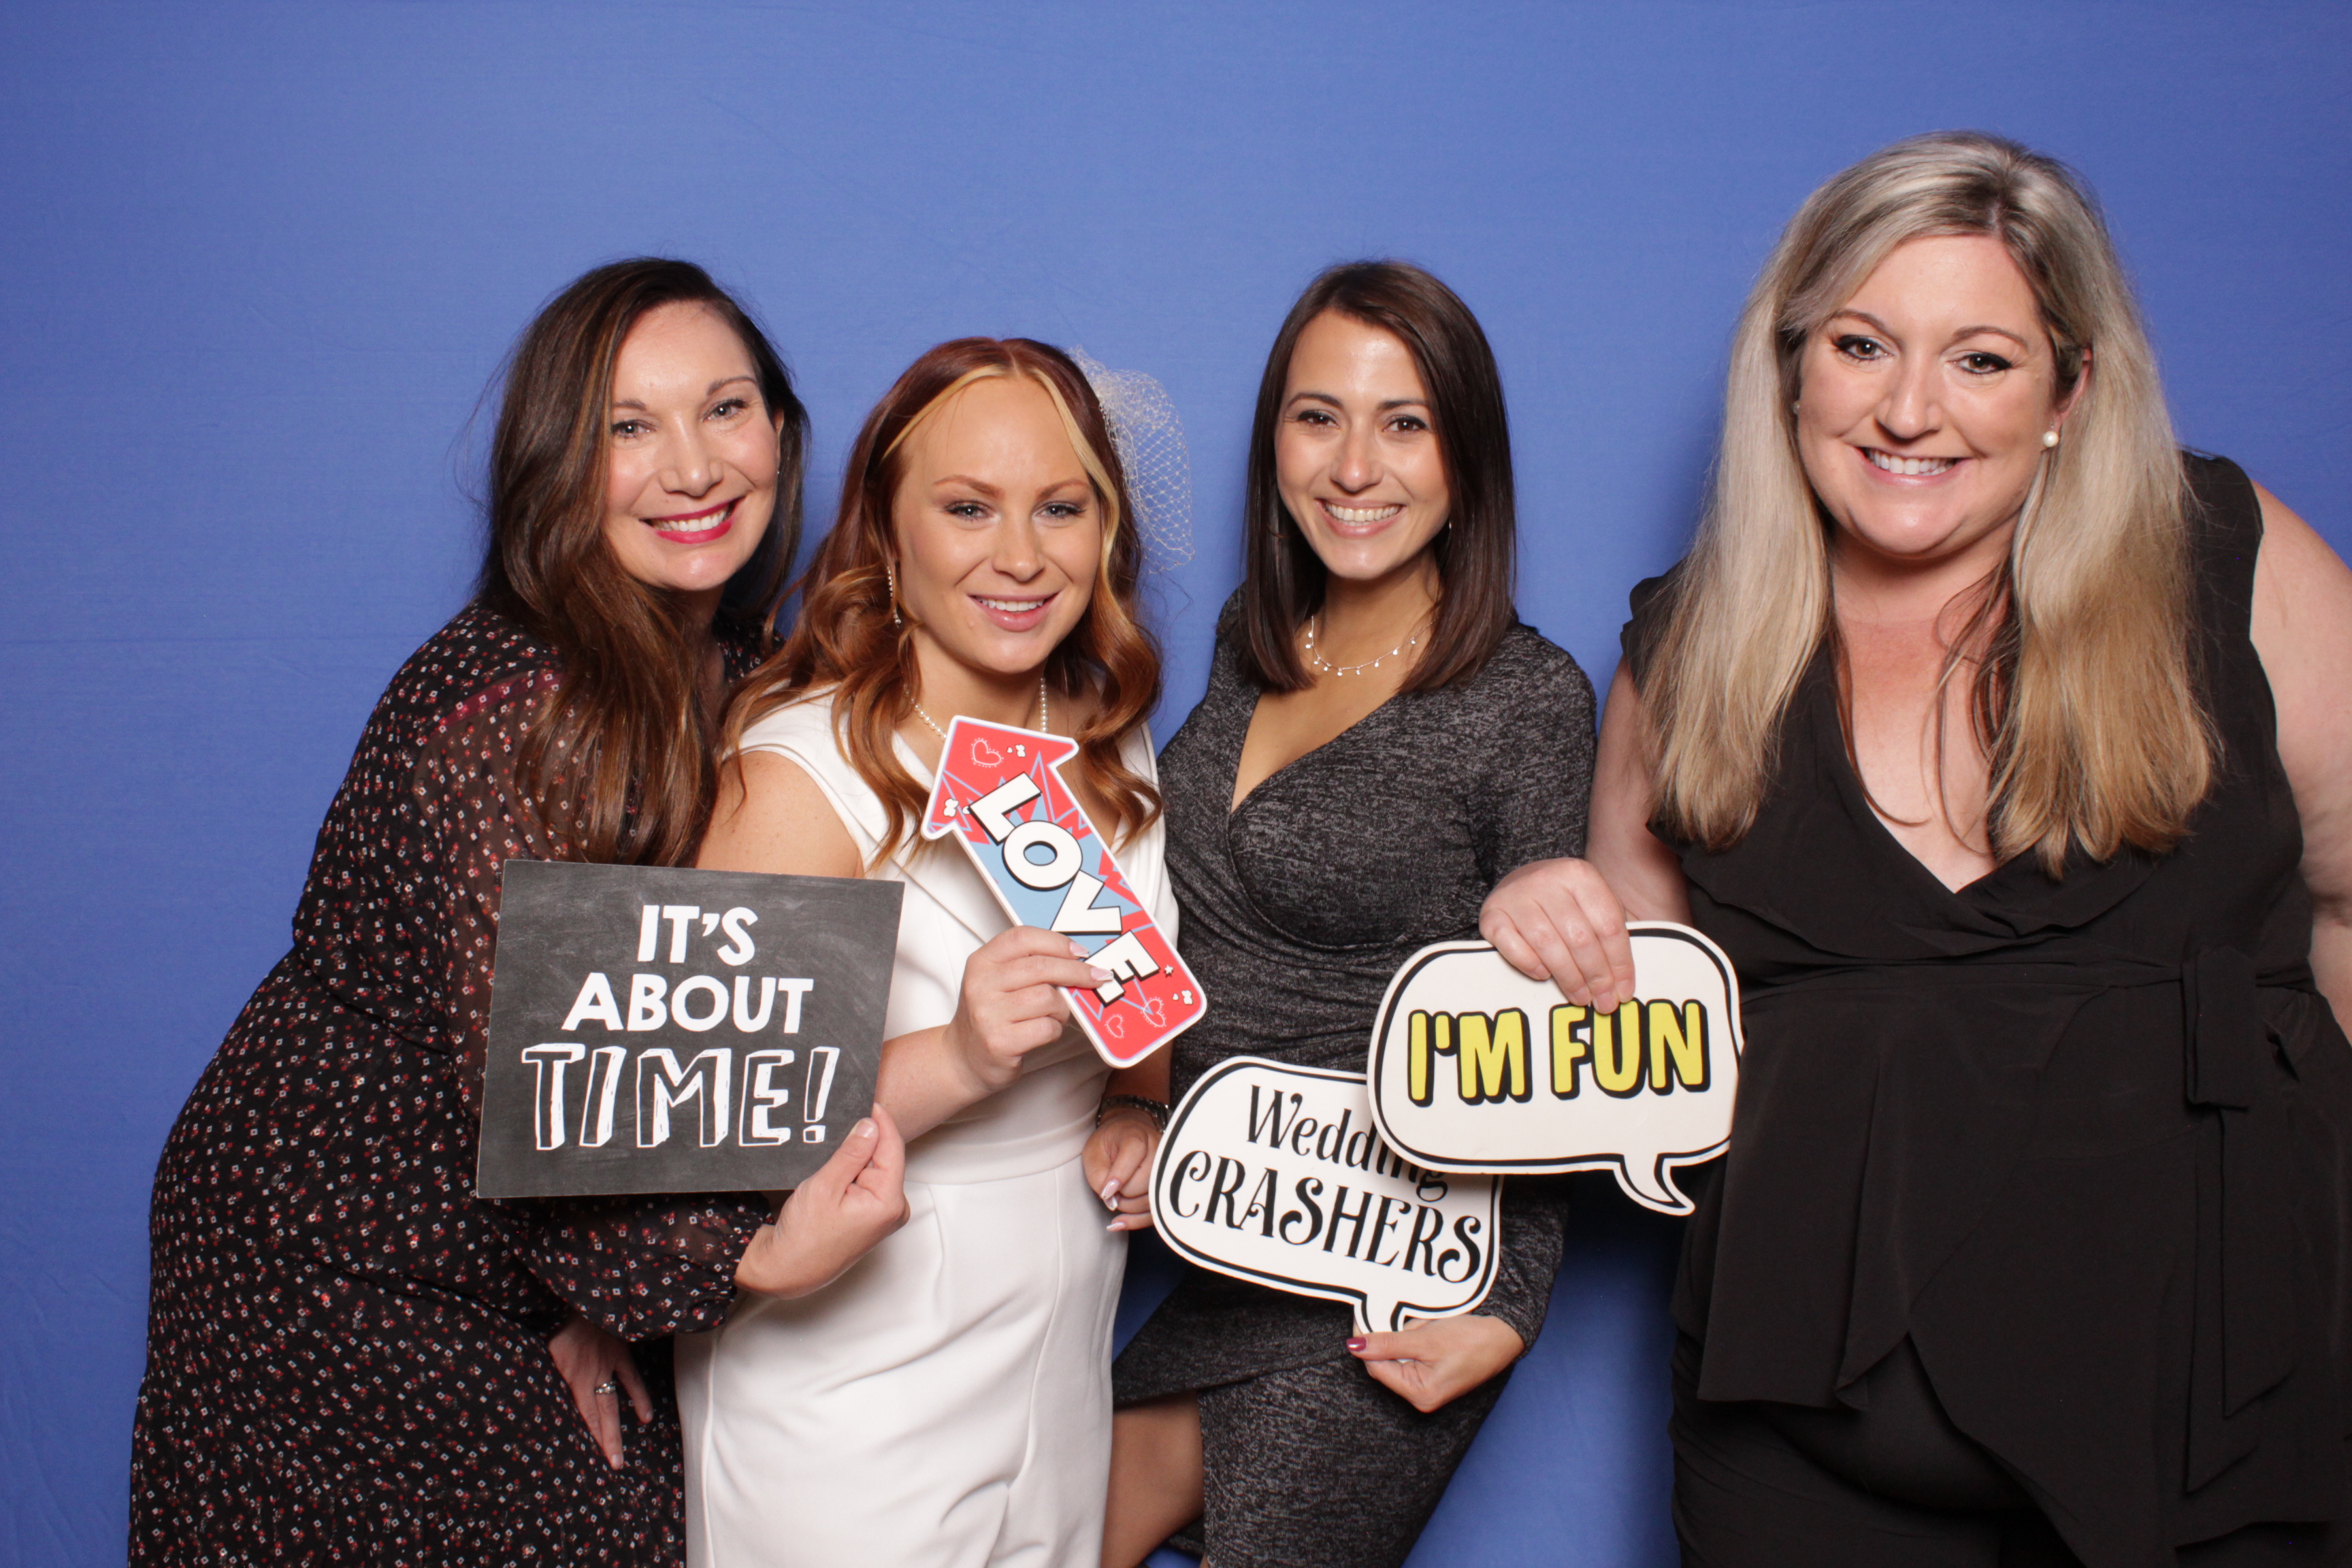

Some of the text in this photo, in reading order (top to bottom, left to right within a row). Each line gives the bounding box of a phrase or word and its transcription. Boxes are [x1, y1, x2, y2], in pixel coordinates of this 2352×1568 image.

[637, 904, 759, 966] IT'S
[968, 771, 1160, 1008] LOVE
[561, 971, 815, 1034] ABOUT
[1407, 997, 1712, 1108] I'M FUN
[521, 1043, 840, 1151] TIME!
[1169, 1149, 1482, 1284] CRASHERS
